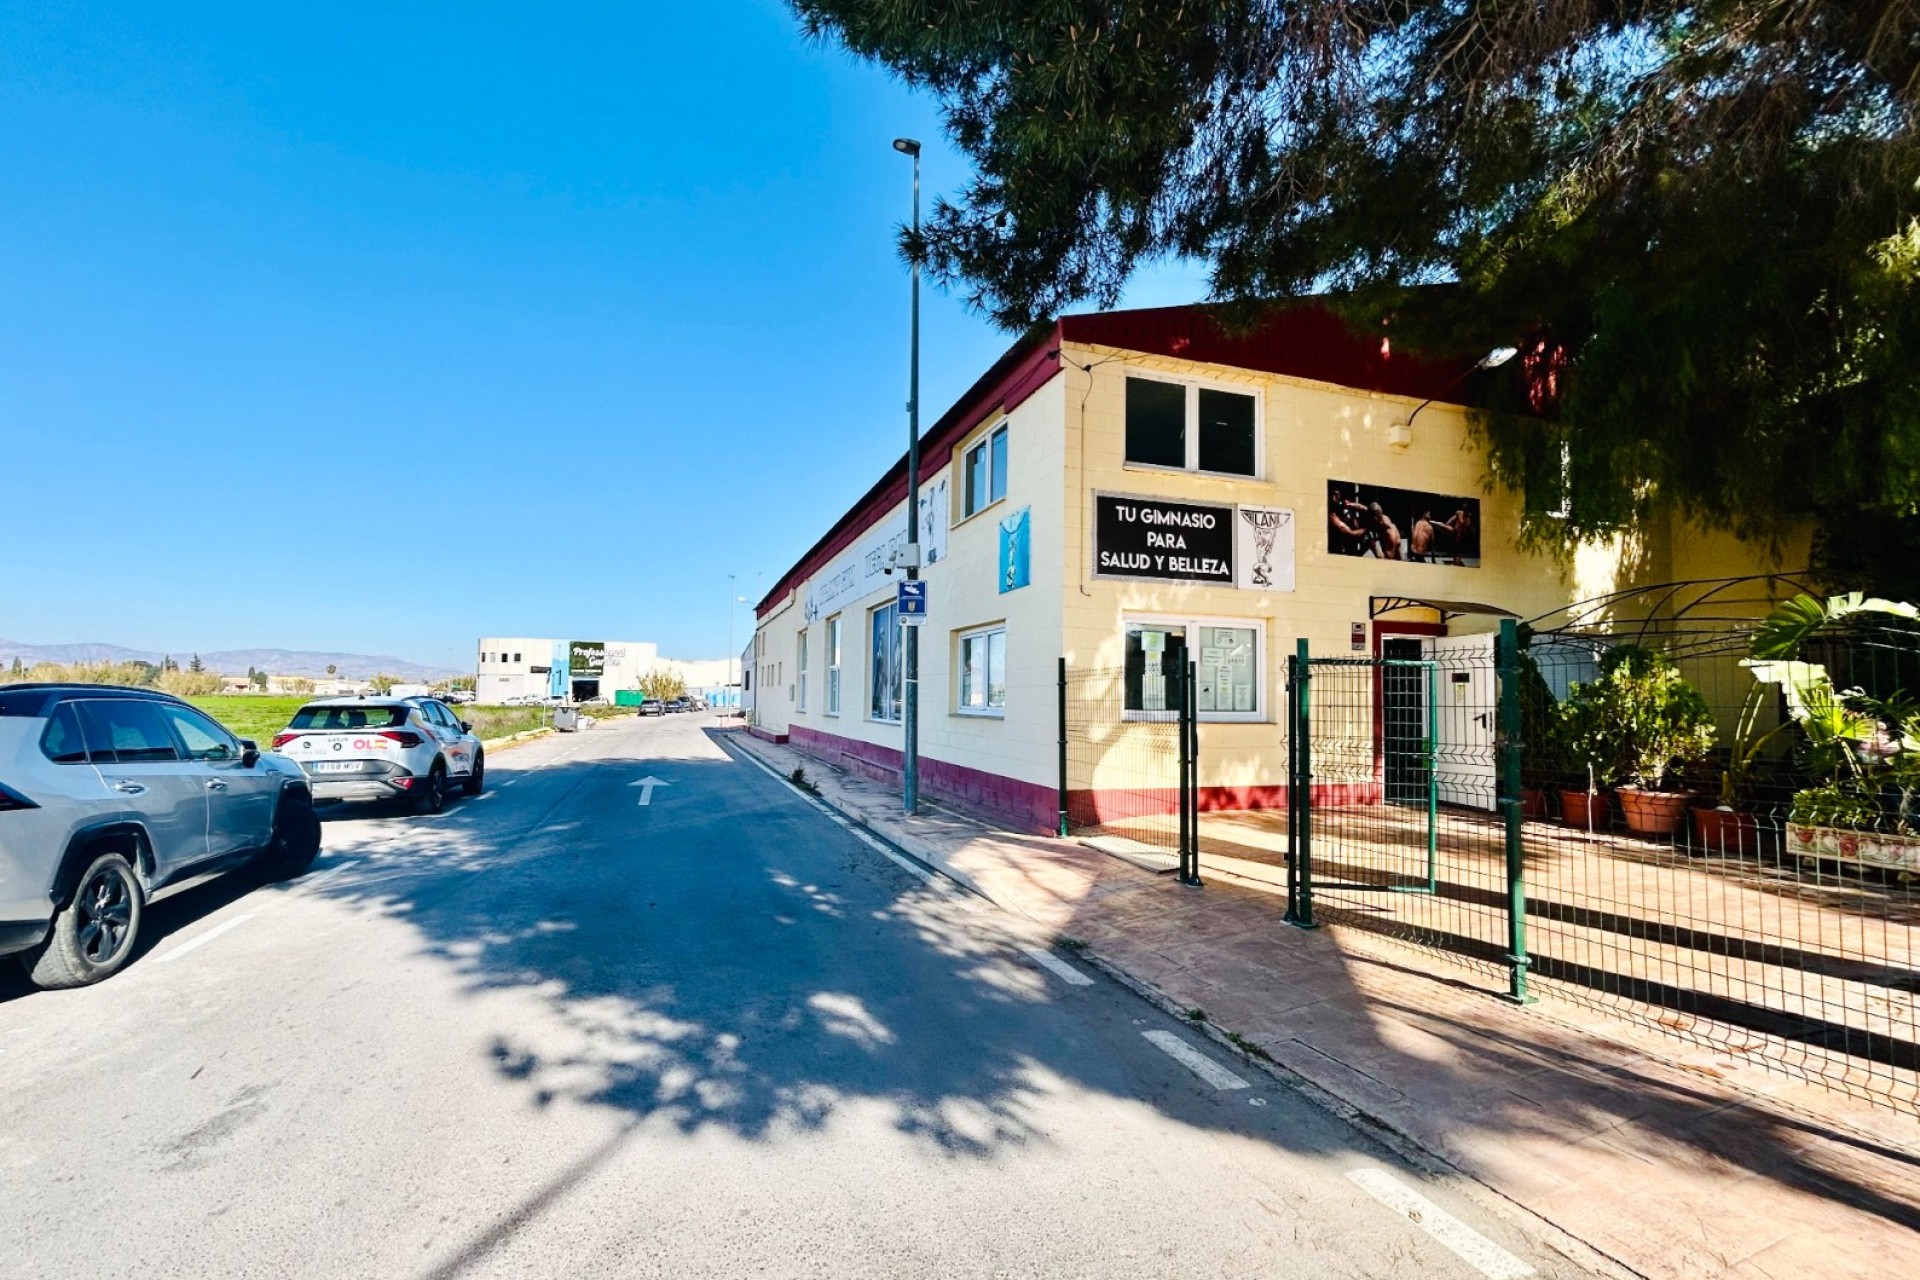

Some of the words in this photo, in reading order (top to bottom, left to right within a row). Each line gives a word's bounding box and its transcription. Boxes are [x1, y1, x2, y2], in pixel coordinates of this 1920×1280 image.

[1115, 505, 1136, 522] TU
[1140, 508, 1216, 529] GIMNASIO
[1147, 531, 1187, 549] PARA
[1100, 551, 1151, 570] SALUD
[1154, 555, 1165, 571] Y
[1169, 557, 1229, 575] BELLEZA
